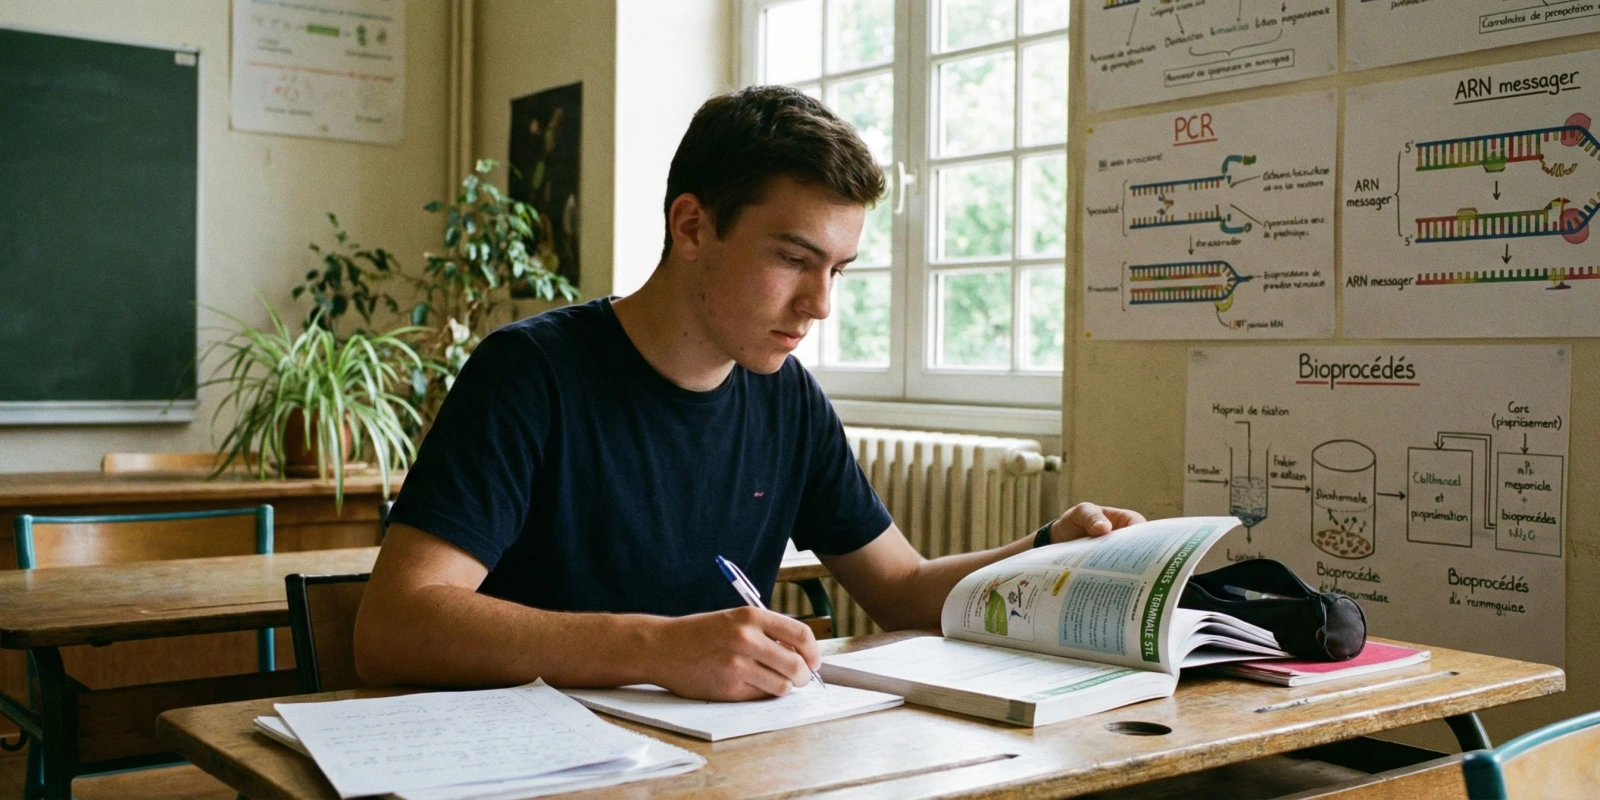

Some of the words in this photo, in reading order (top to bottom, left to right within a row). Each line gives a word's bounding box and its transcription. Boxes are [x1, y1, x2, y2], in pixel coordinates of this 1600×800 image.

[1530, 10, 1541, 21] de
[1455, 76, 1492, 100] ARN
[1499, 71, 1579, 95] messager
[1174, 113, 1215, 141] PCR
[1354, 178, 1379, 193] ARN
[1346, 195, 1392, 210] messager
[1346, 275, 1368, 288] ARN
[1371, 277, 1414, 291] messager
[1299, 353, 1416, 390] Bioprocédés
[1247, 405, 1258, 416] de
[1435, 493, 1444, 503] et
[1448, 567, 1529, 594] Bioprocédés
[1144, 641, 1154, 657] STL
